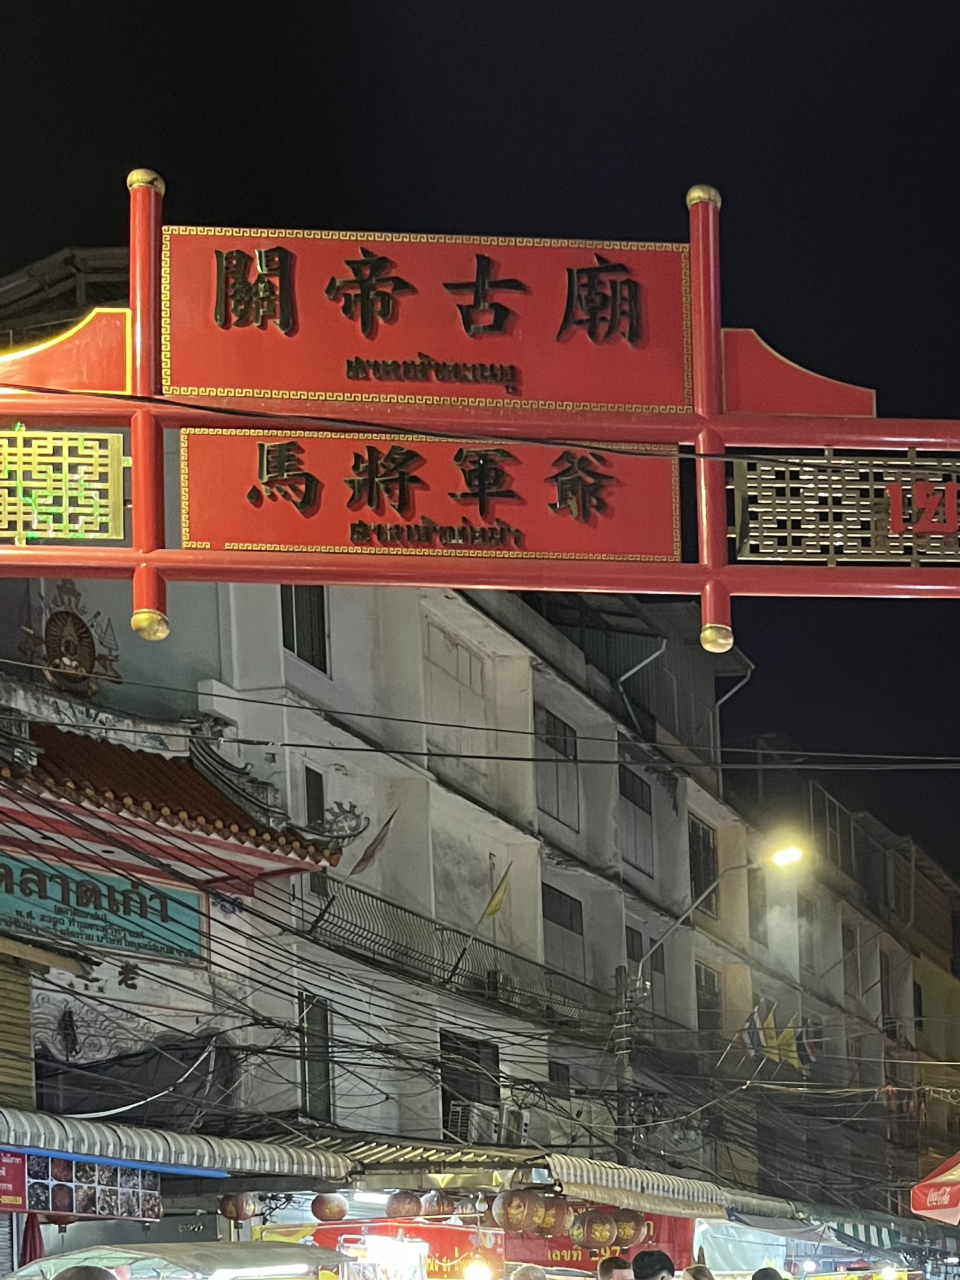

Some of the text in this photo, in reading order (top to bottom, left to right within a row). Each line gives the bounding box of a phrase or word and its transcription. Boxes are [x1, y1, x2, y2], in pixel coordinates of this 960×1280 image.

[213, 246, 644, 348] 關帝古廟
[246, 440, 618, 522] 馬將軍爺
[927, 1186, 951, 1206] Coca-Cola
